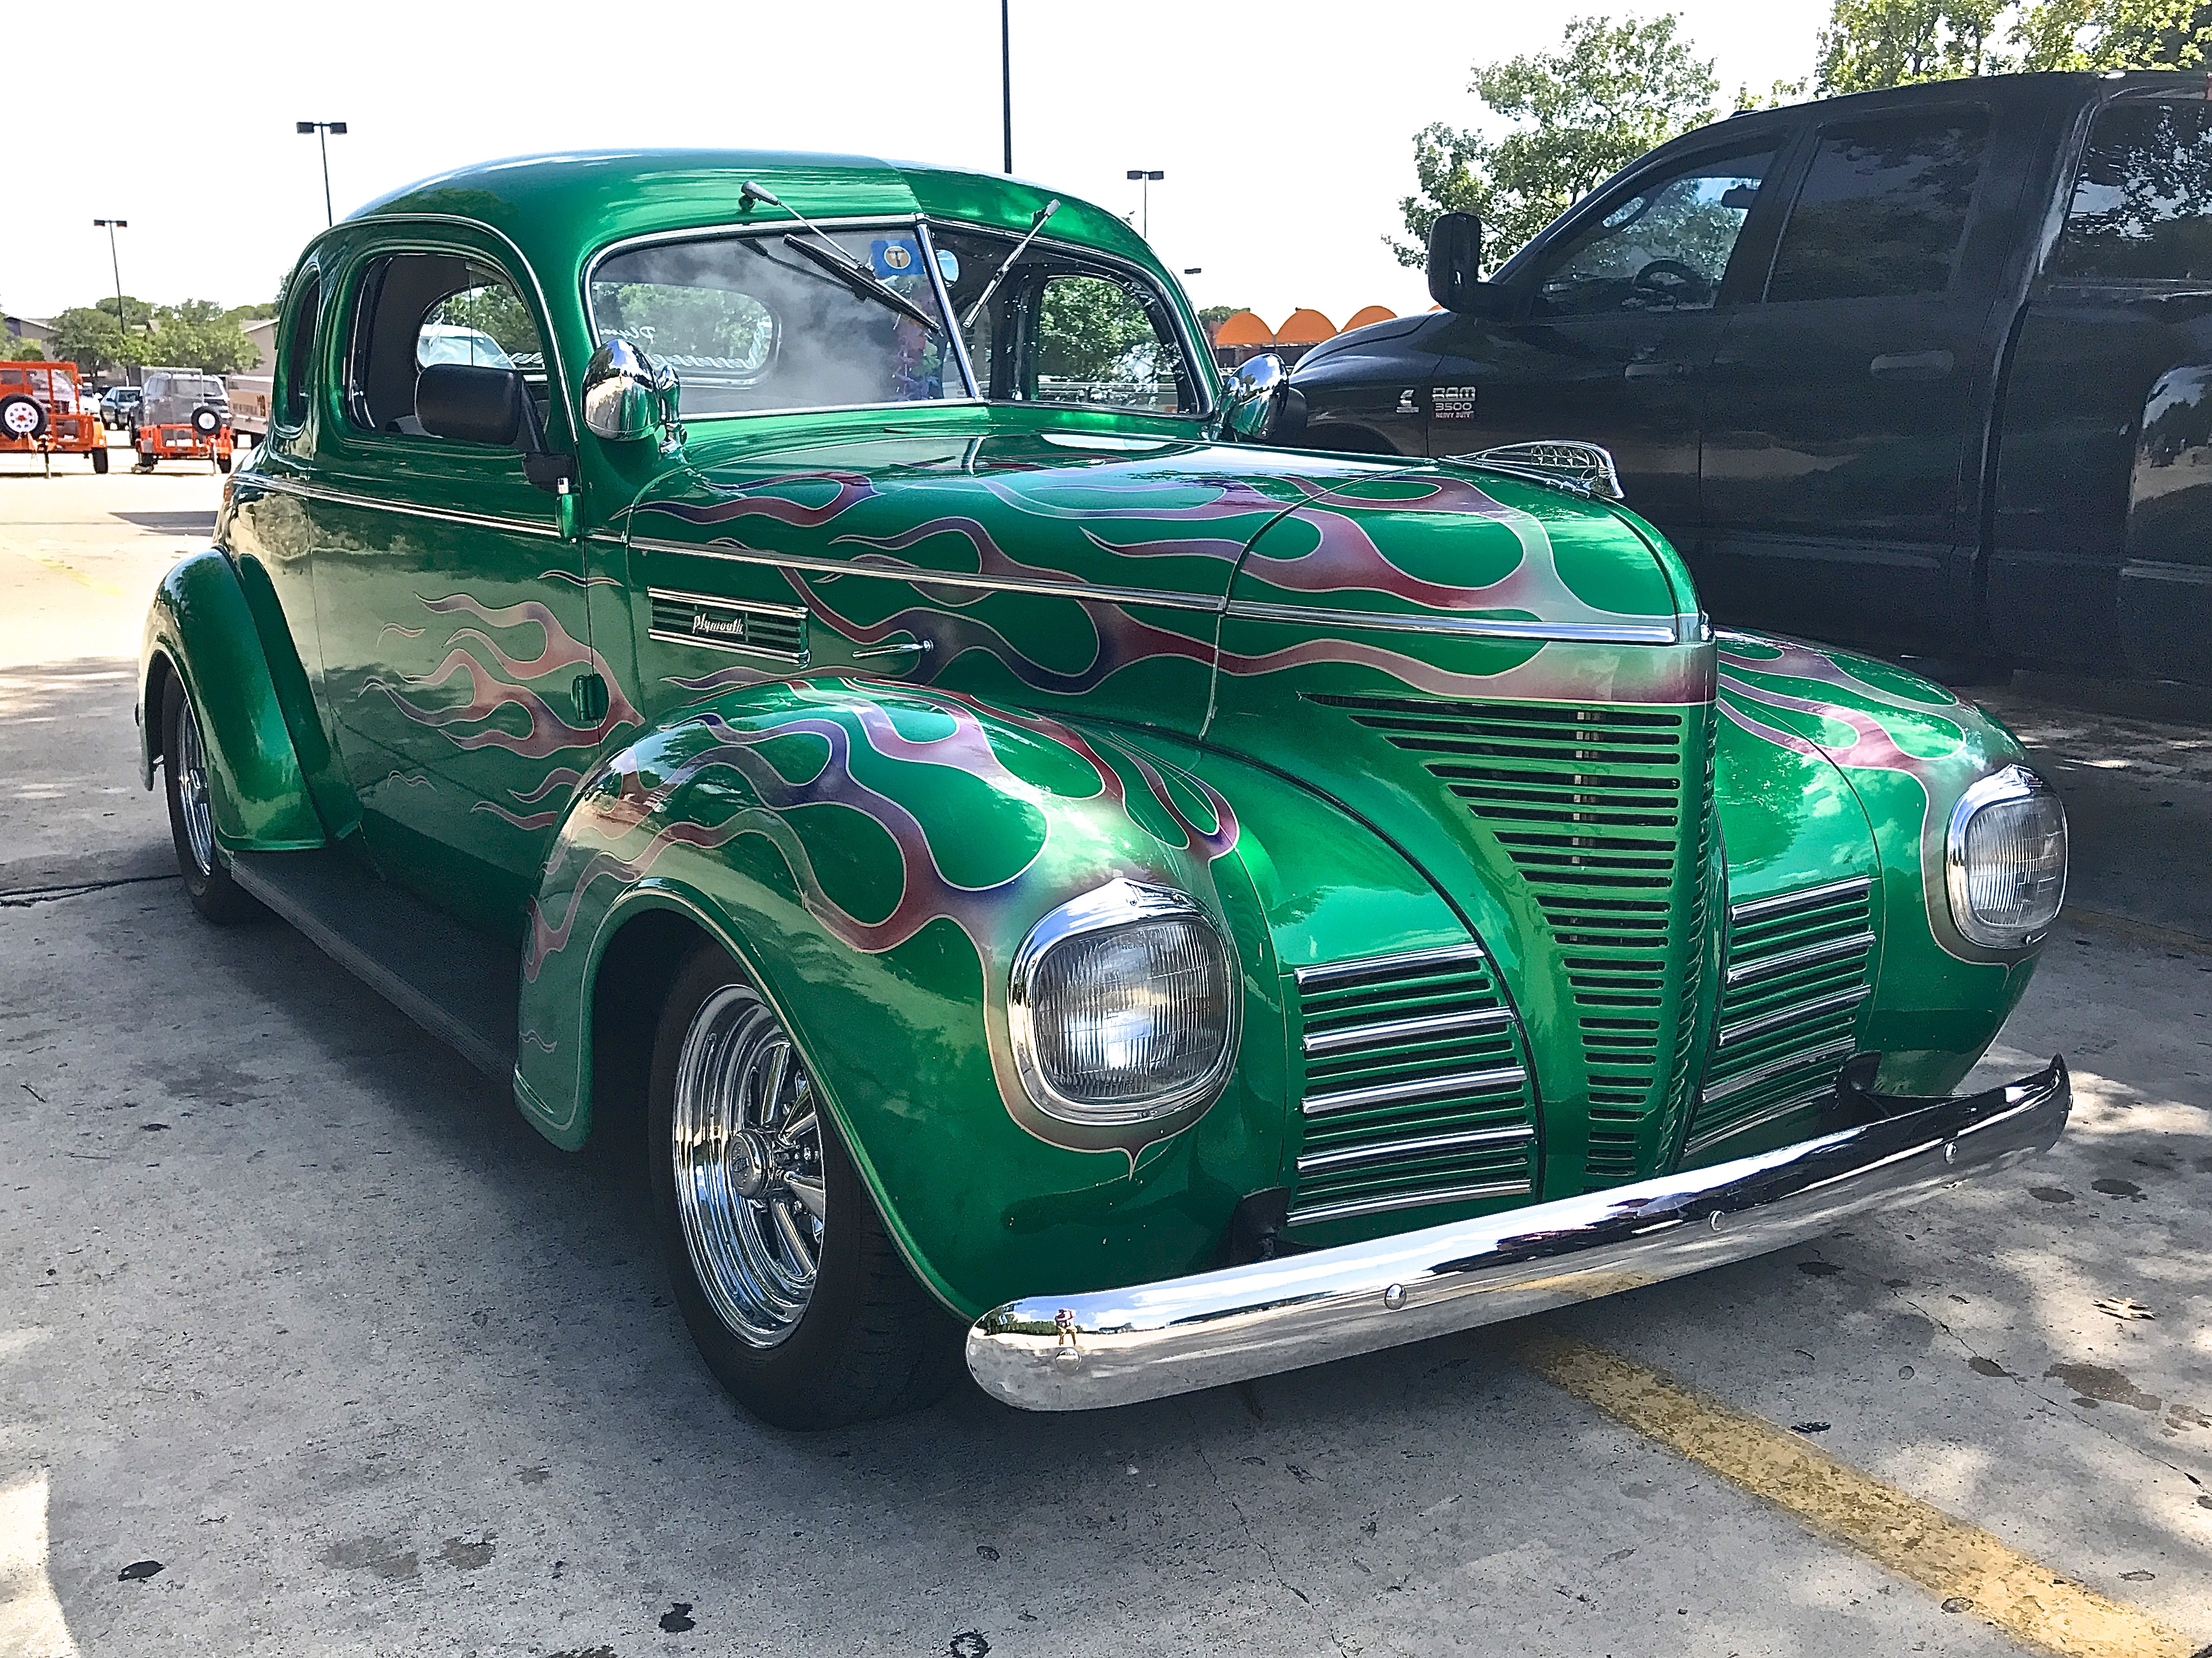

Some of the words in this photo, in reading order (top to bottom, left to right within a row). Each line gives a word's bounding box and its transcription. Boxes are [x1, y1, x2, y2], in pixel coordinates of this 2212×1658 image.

[1432, 387, 1476, 402] RAM
[1435, 402, 1472, 411] 3500
[692, 612, 743, 634] Plymouth
